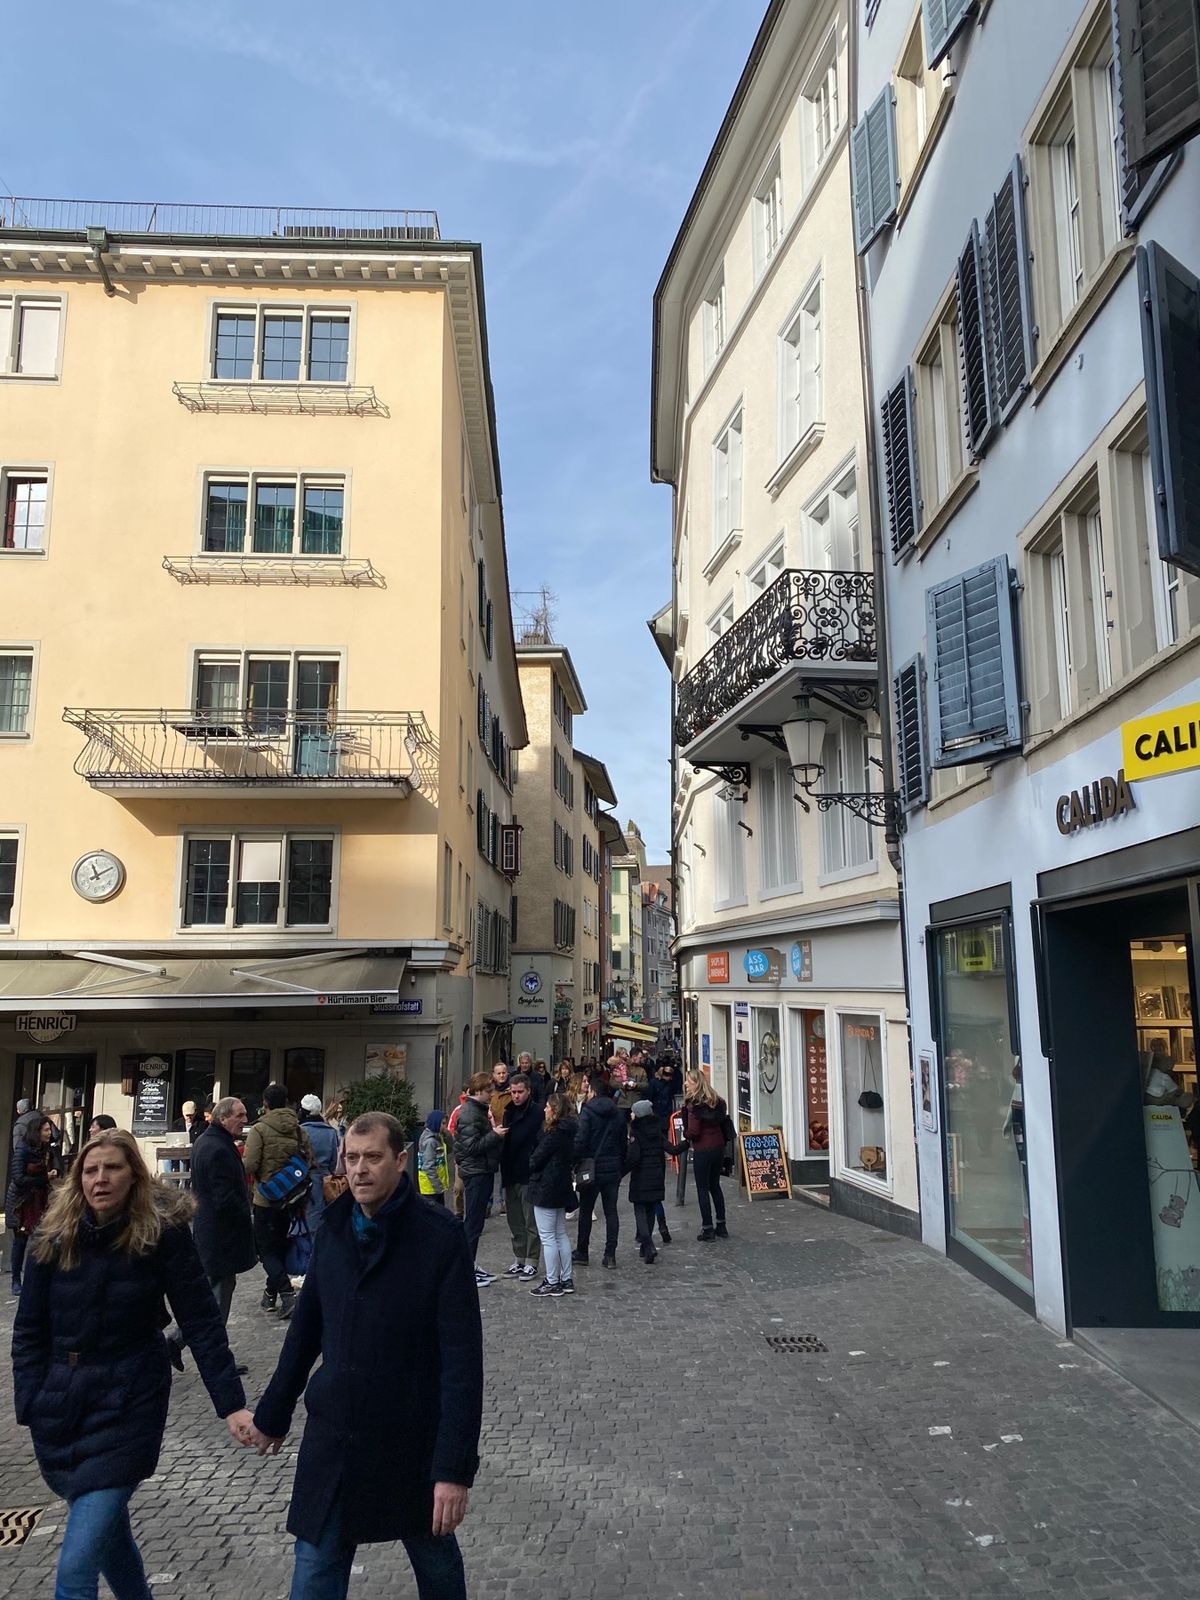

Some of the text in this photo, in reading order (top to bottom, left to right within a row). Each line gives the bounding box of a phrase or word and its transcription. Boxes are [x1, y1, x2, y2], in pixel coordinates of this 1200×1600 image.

[1135, 720, 1200, 761] CALI
[1056, 769, 1136, 835] CALIDA
[749, 964, 764, 974] BAR
[327, 995, 387, 1004] Hürlimann Bier
[18, 1016, 73, 1030] HENRICI
